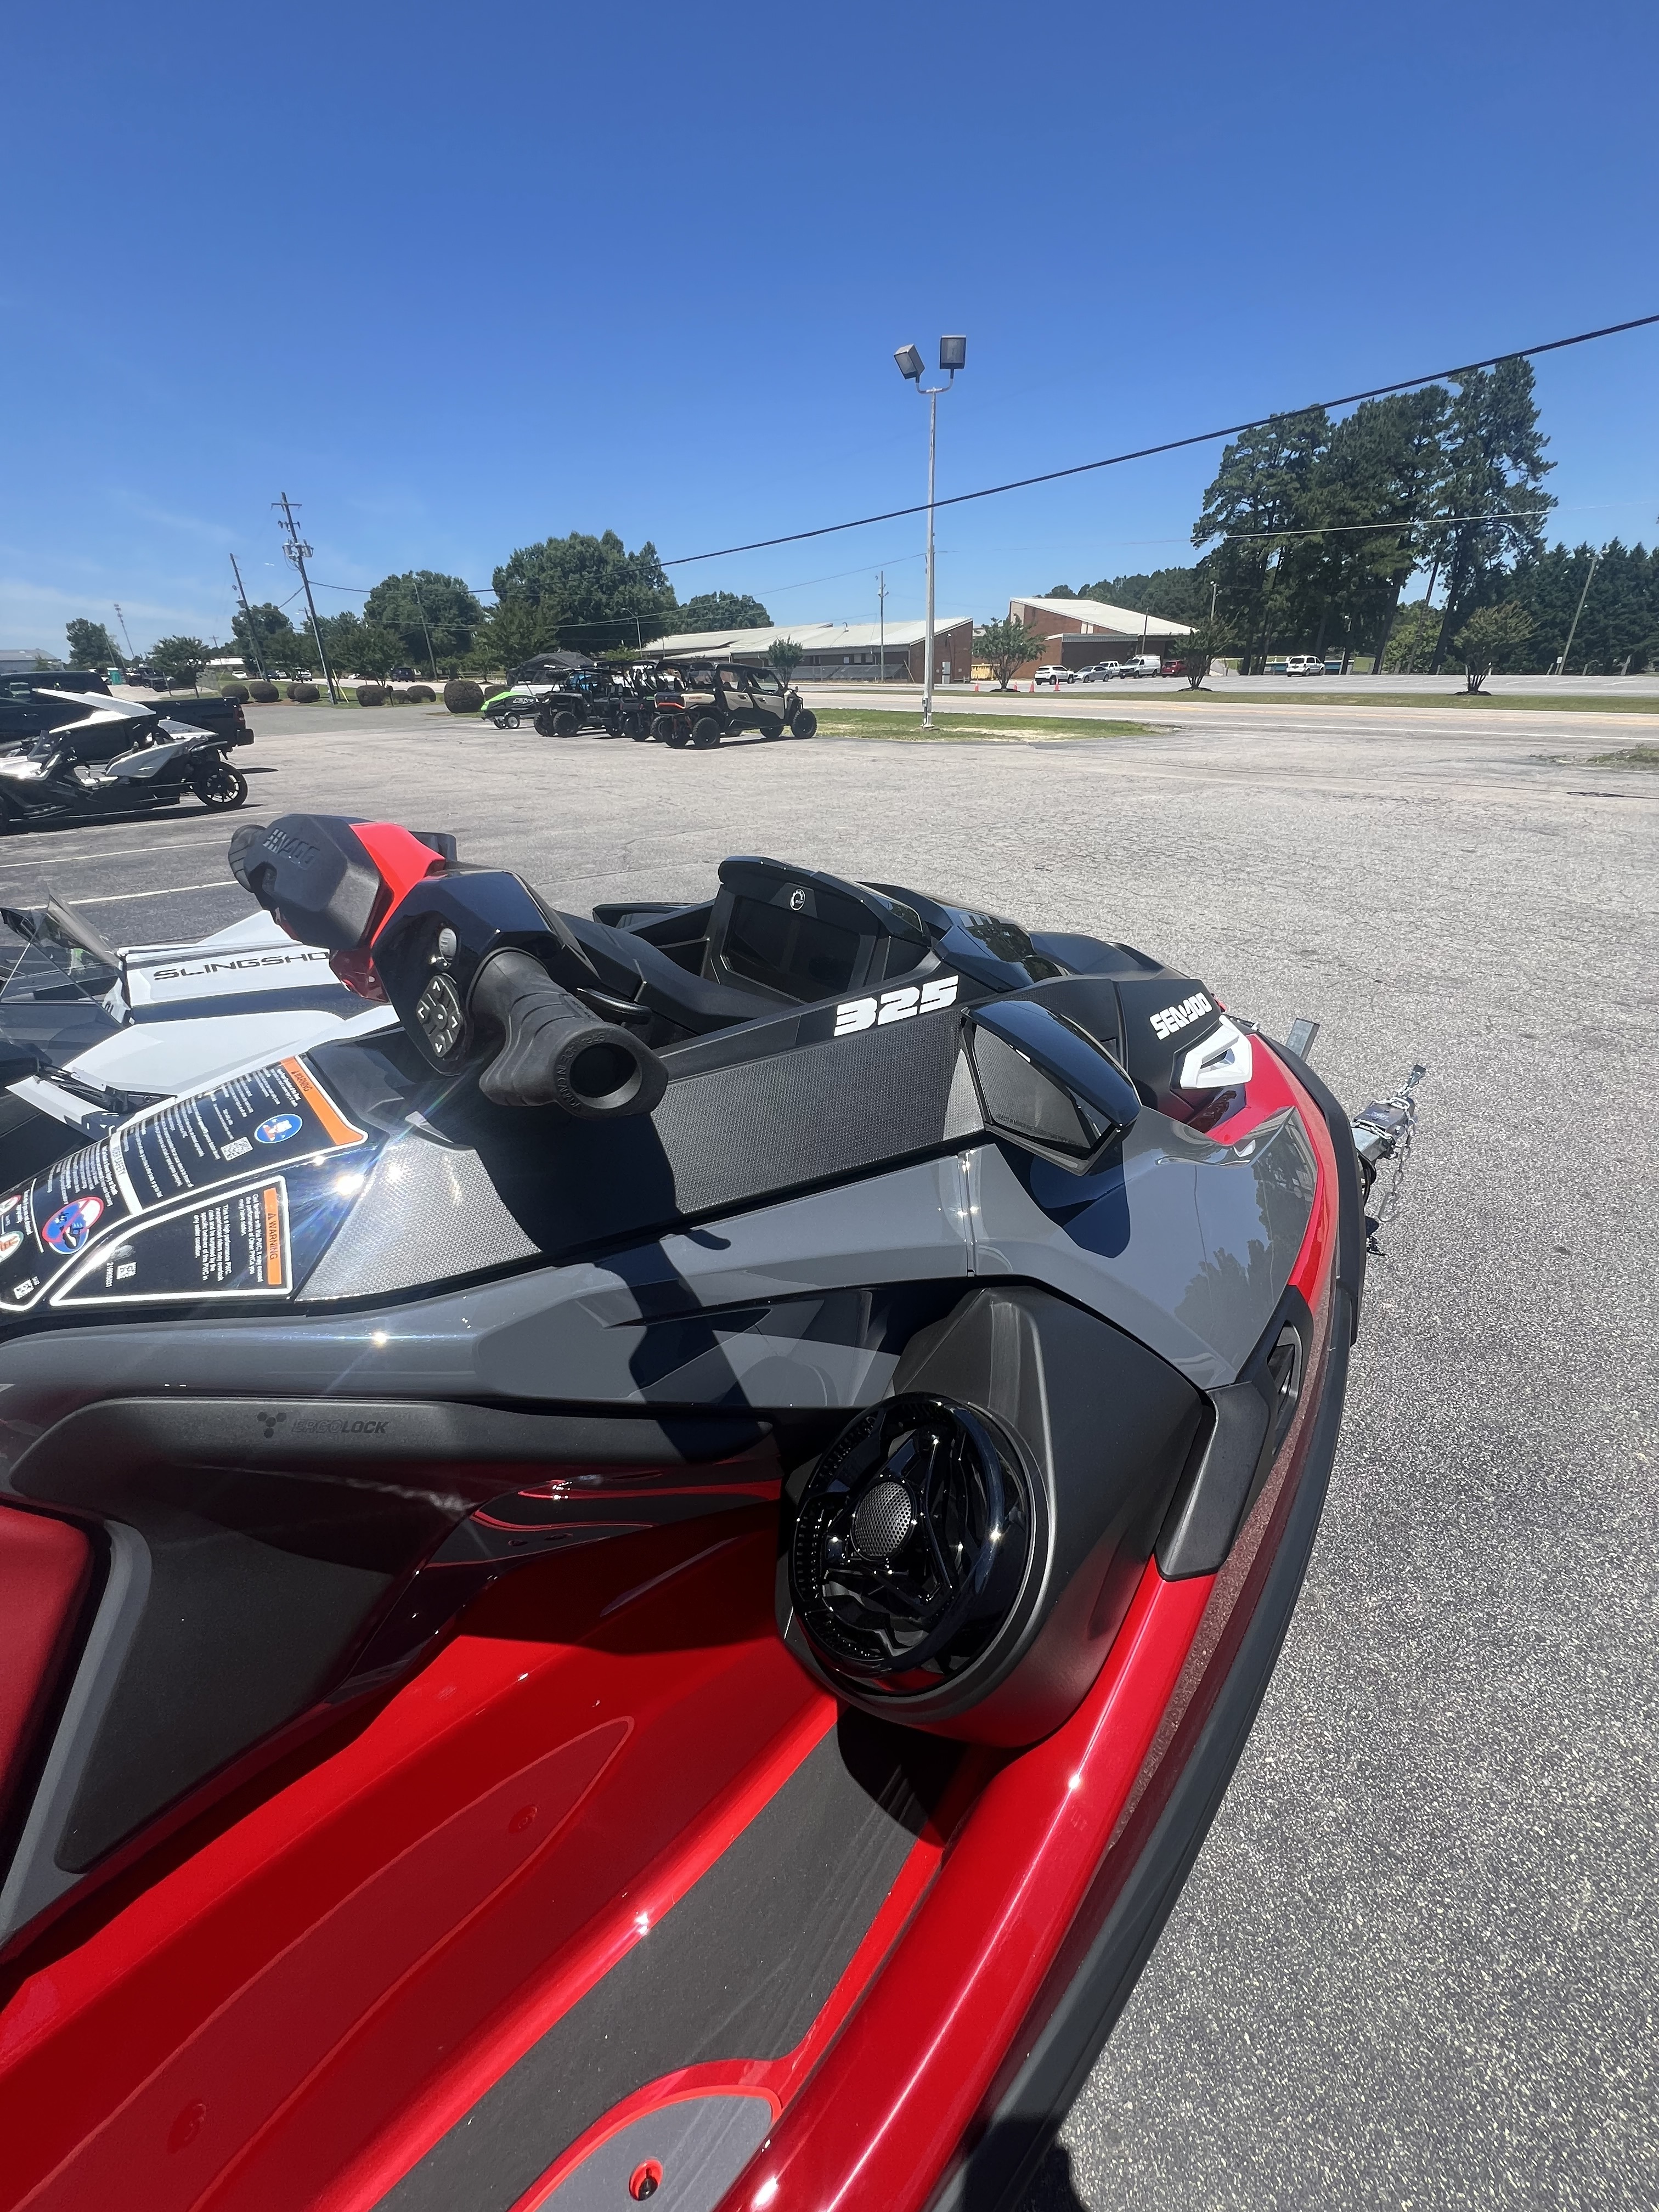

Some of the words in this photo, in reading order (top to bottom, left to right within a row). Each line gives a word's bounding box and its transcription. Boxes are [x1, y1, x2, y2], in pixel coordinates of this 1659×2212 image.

[833, 975, 959, 1037] 325
[295, 1071, 313, 1092] WARNING
[268, 1221, 278, 1260] WARNING
[291, 1418, 391, 1434] ERGOLOCK
